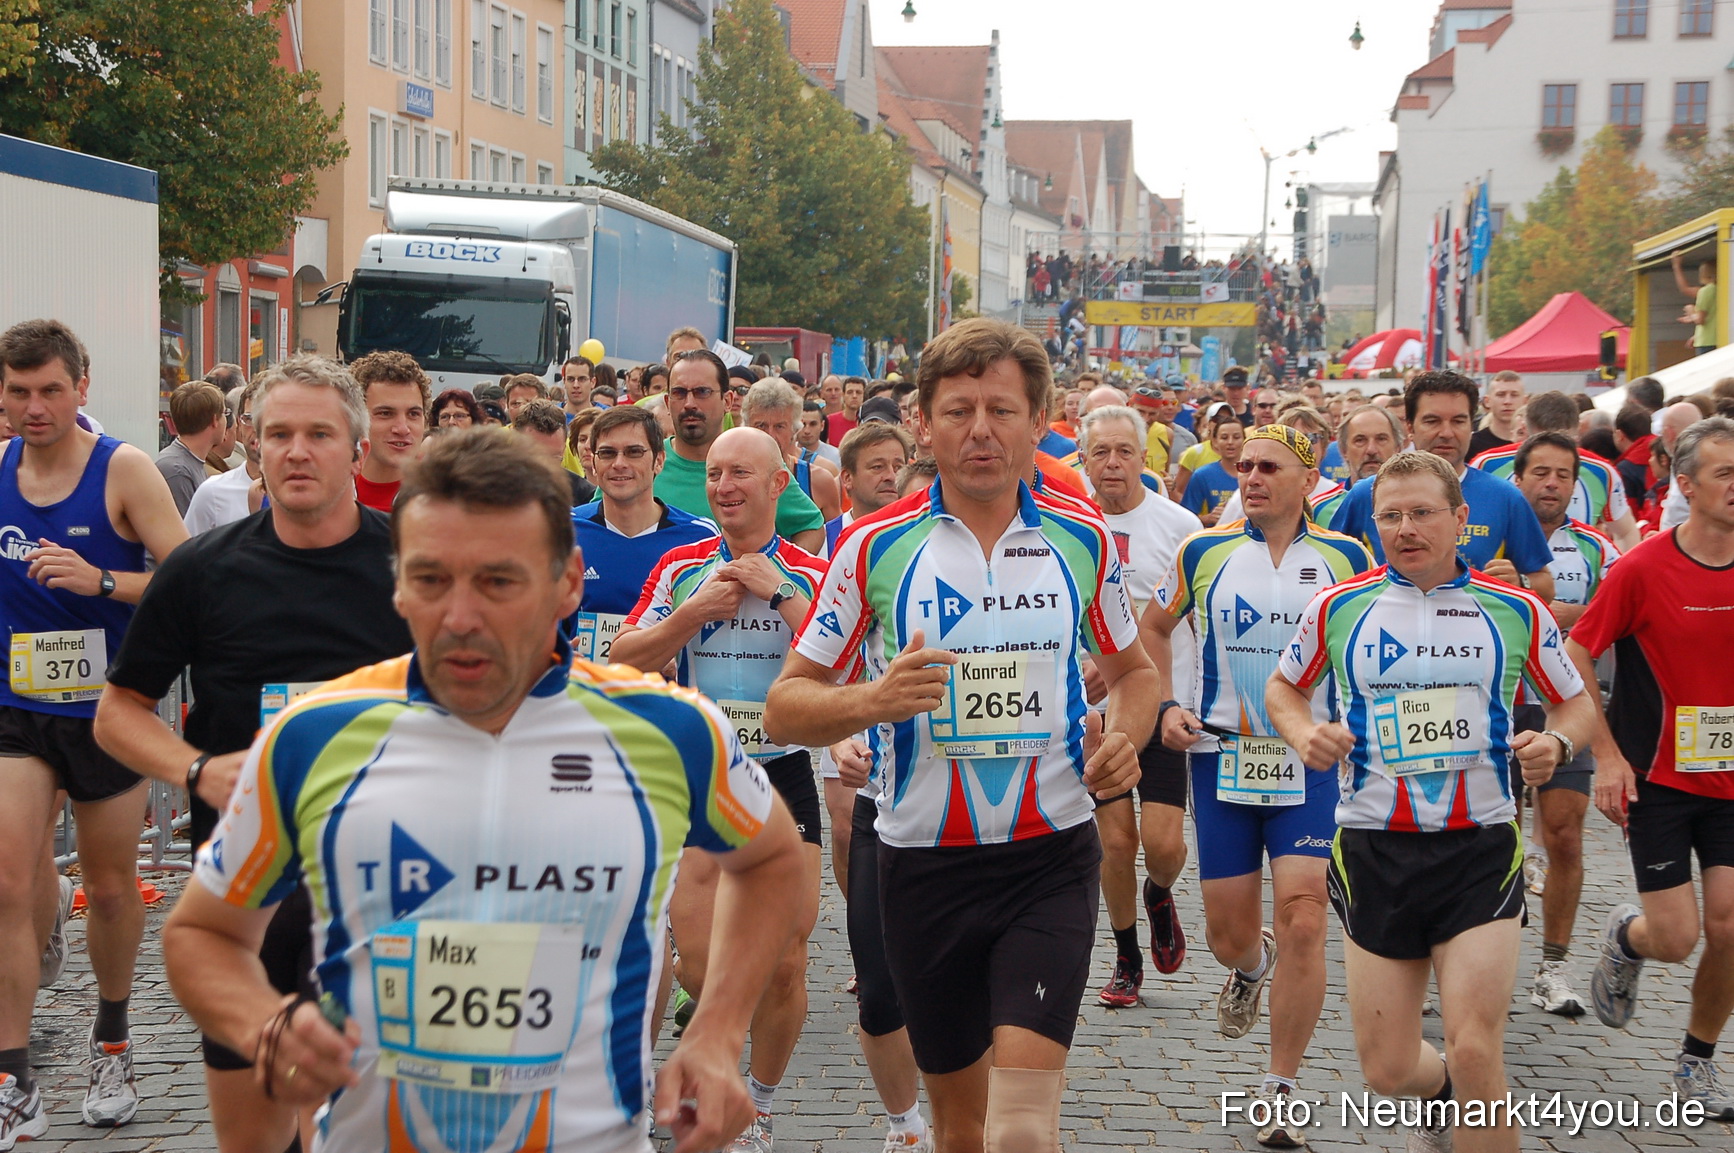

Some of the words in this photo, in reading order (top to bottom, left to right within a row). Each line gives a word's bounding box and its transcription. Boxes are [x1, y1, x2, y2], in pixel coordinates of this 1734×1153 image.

[405, 242, 501, 263] BOCK
[1141, 307, 1199, 321] START
[1555, 572, 1582, 582] AST
[983, 594, 1059, 612] PLAST
[730, 618, 782, 631] PLAST
[36, 636, 86, 652] Manfred
[581, 637, 587, 646] C
[693, 649, 782, 660] www.tr-plast.de
[1225, 645, 1285, 657] www.tr-p
[1416, 645, 1483, 659] PLAST
[15, 661, 21, 671] B
[46, 658, 91, 680] 370
[961, 660, 1017, 680] Konrad
[721, 705, 762, 720] Werner
[965, 691, 1042, 719] 2654
[1402, 700, 1430, 714] Rico
[1383, 726, 1389, 737] B
[1407, 718, 1470, 744] 2648
[1243, 741, 1287, 755] Matthias
[1708, 732, 1733, 749] 78
[1225, 759, 1230, 768] B
[1244, 762, 1294, 780] 2644
[1309, 838, 1334, 848] asics
[474, 864, 623, 893] PLAST
[429, 935, 478, 965] Max
[385, 978, 395, 998] B
[428, 984, 553, 1030] 2653
